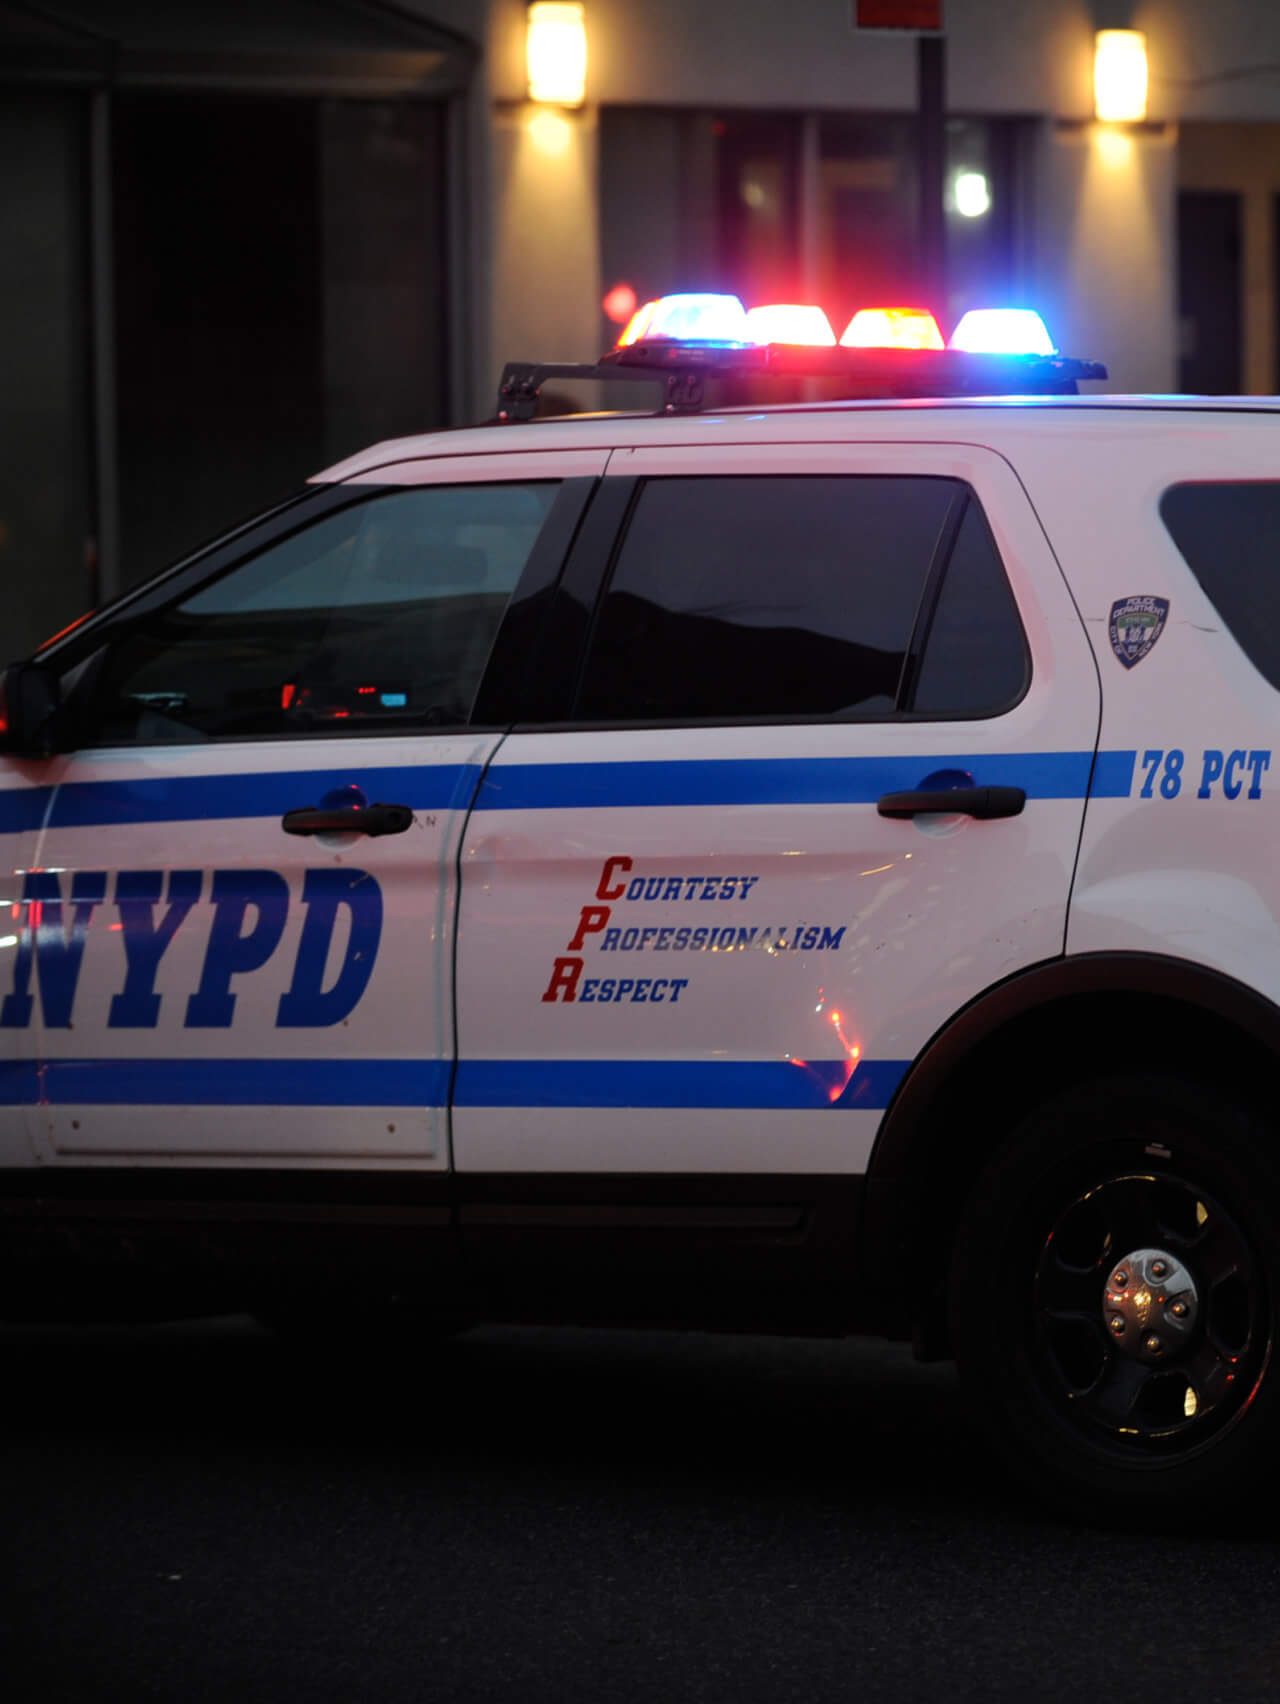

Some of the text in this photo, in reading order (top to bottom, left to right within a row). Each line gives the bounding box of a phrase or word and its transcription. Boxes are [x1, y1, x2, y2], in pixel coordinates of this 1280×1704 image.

[1140, 749, 1272, 801] 78 PCT
[595, 856, 760, 901] COURTESY
[0, 868, 384, 1029] NYPD
[567, 906, 847, 952] PROFESSIONALISM
[541, 957, 688, 1003] RESPECT
